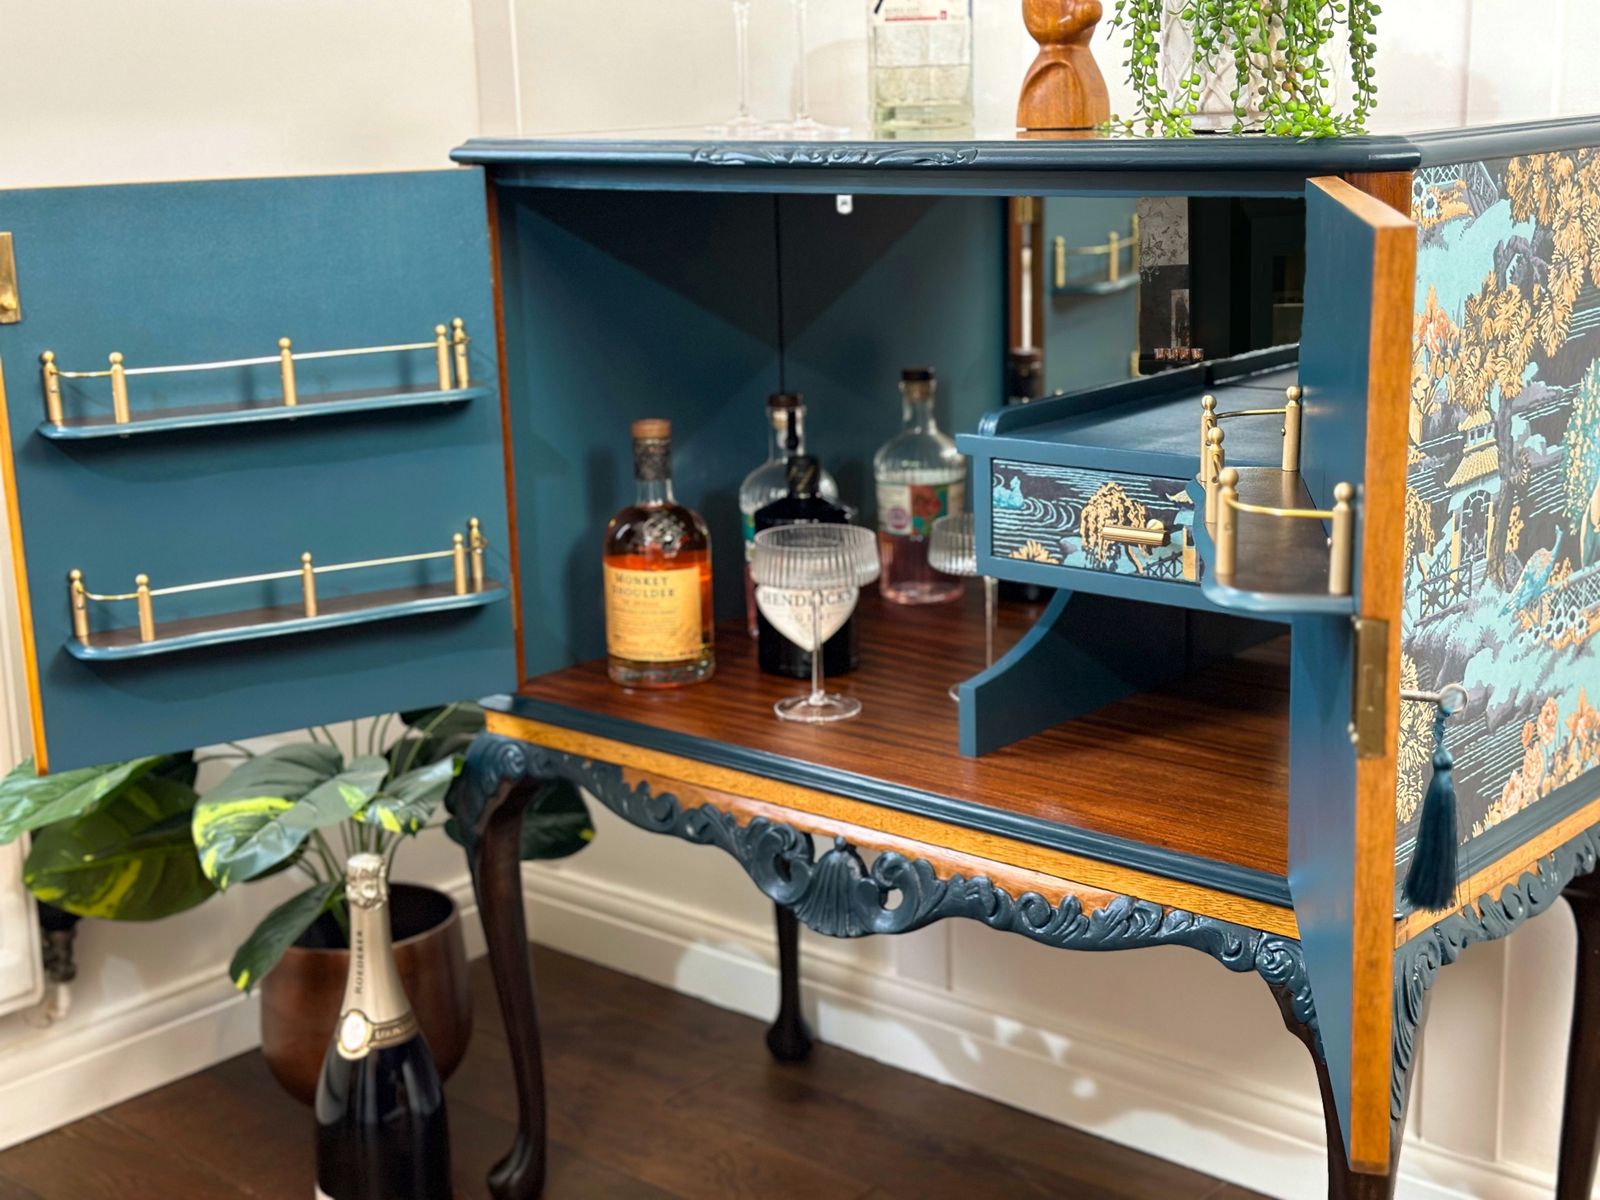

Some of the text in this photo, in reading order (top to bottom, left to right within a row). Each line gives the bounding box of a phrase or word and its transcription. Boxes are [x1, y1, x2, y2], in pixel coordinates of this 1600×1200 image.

[615, 573, 668, 586] MONKEY
[611, 584, 675, 598] SHOULDER
[762, 590, 852, 607] HENDCKS
